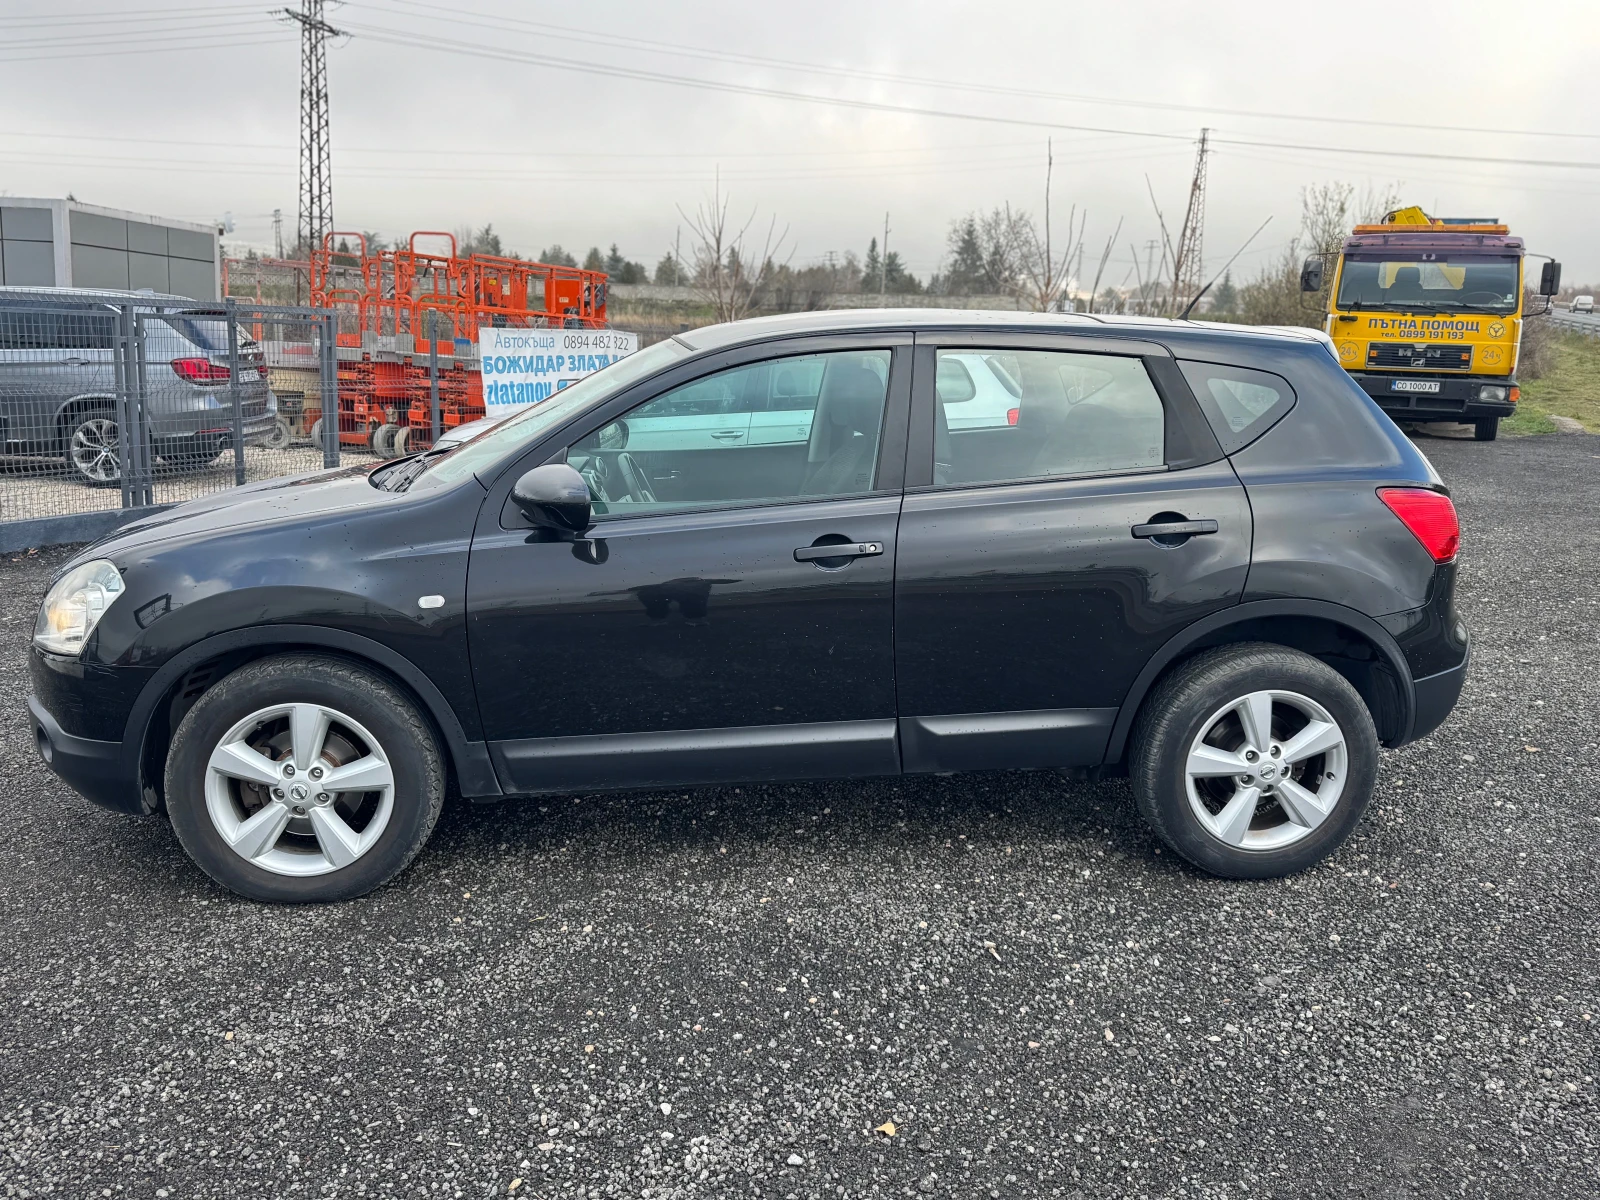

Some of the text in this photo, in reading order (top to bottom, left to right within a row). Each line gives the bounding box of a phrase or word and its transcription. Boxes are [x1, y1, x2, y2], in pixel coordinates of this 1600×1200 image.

[1368, 318, 1480, 333] ПЪТНА ПОМОЩ
[494, 333, 555, 351] Автокъща
[563, 335, 589, 349] 0894
[592, 335, 611, 349] 482
[1399, 330, 1425, 339] 0899
[1428, 331, 1444, 339] 191
[1447, 331, 1464, 340] 193
[1398, 348, 1441, 358] MN
[482, 354, 625, 376] БОЖИДАР ЗЛАТА
[486, 379, 552, 405] zlatanov
[1396, 381, 1439, 391] CO 1000 AT
